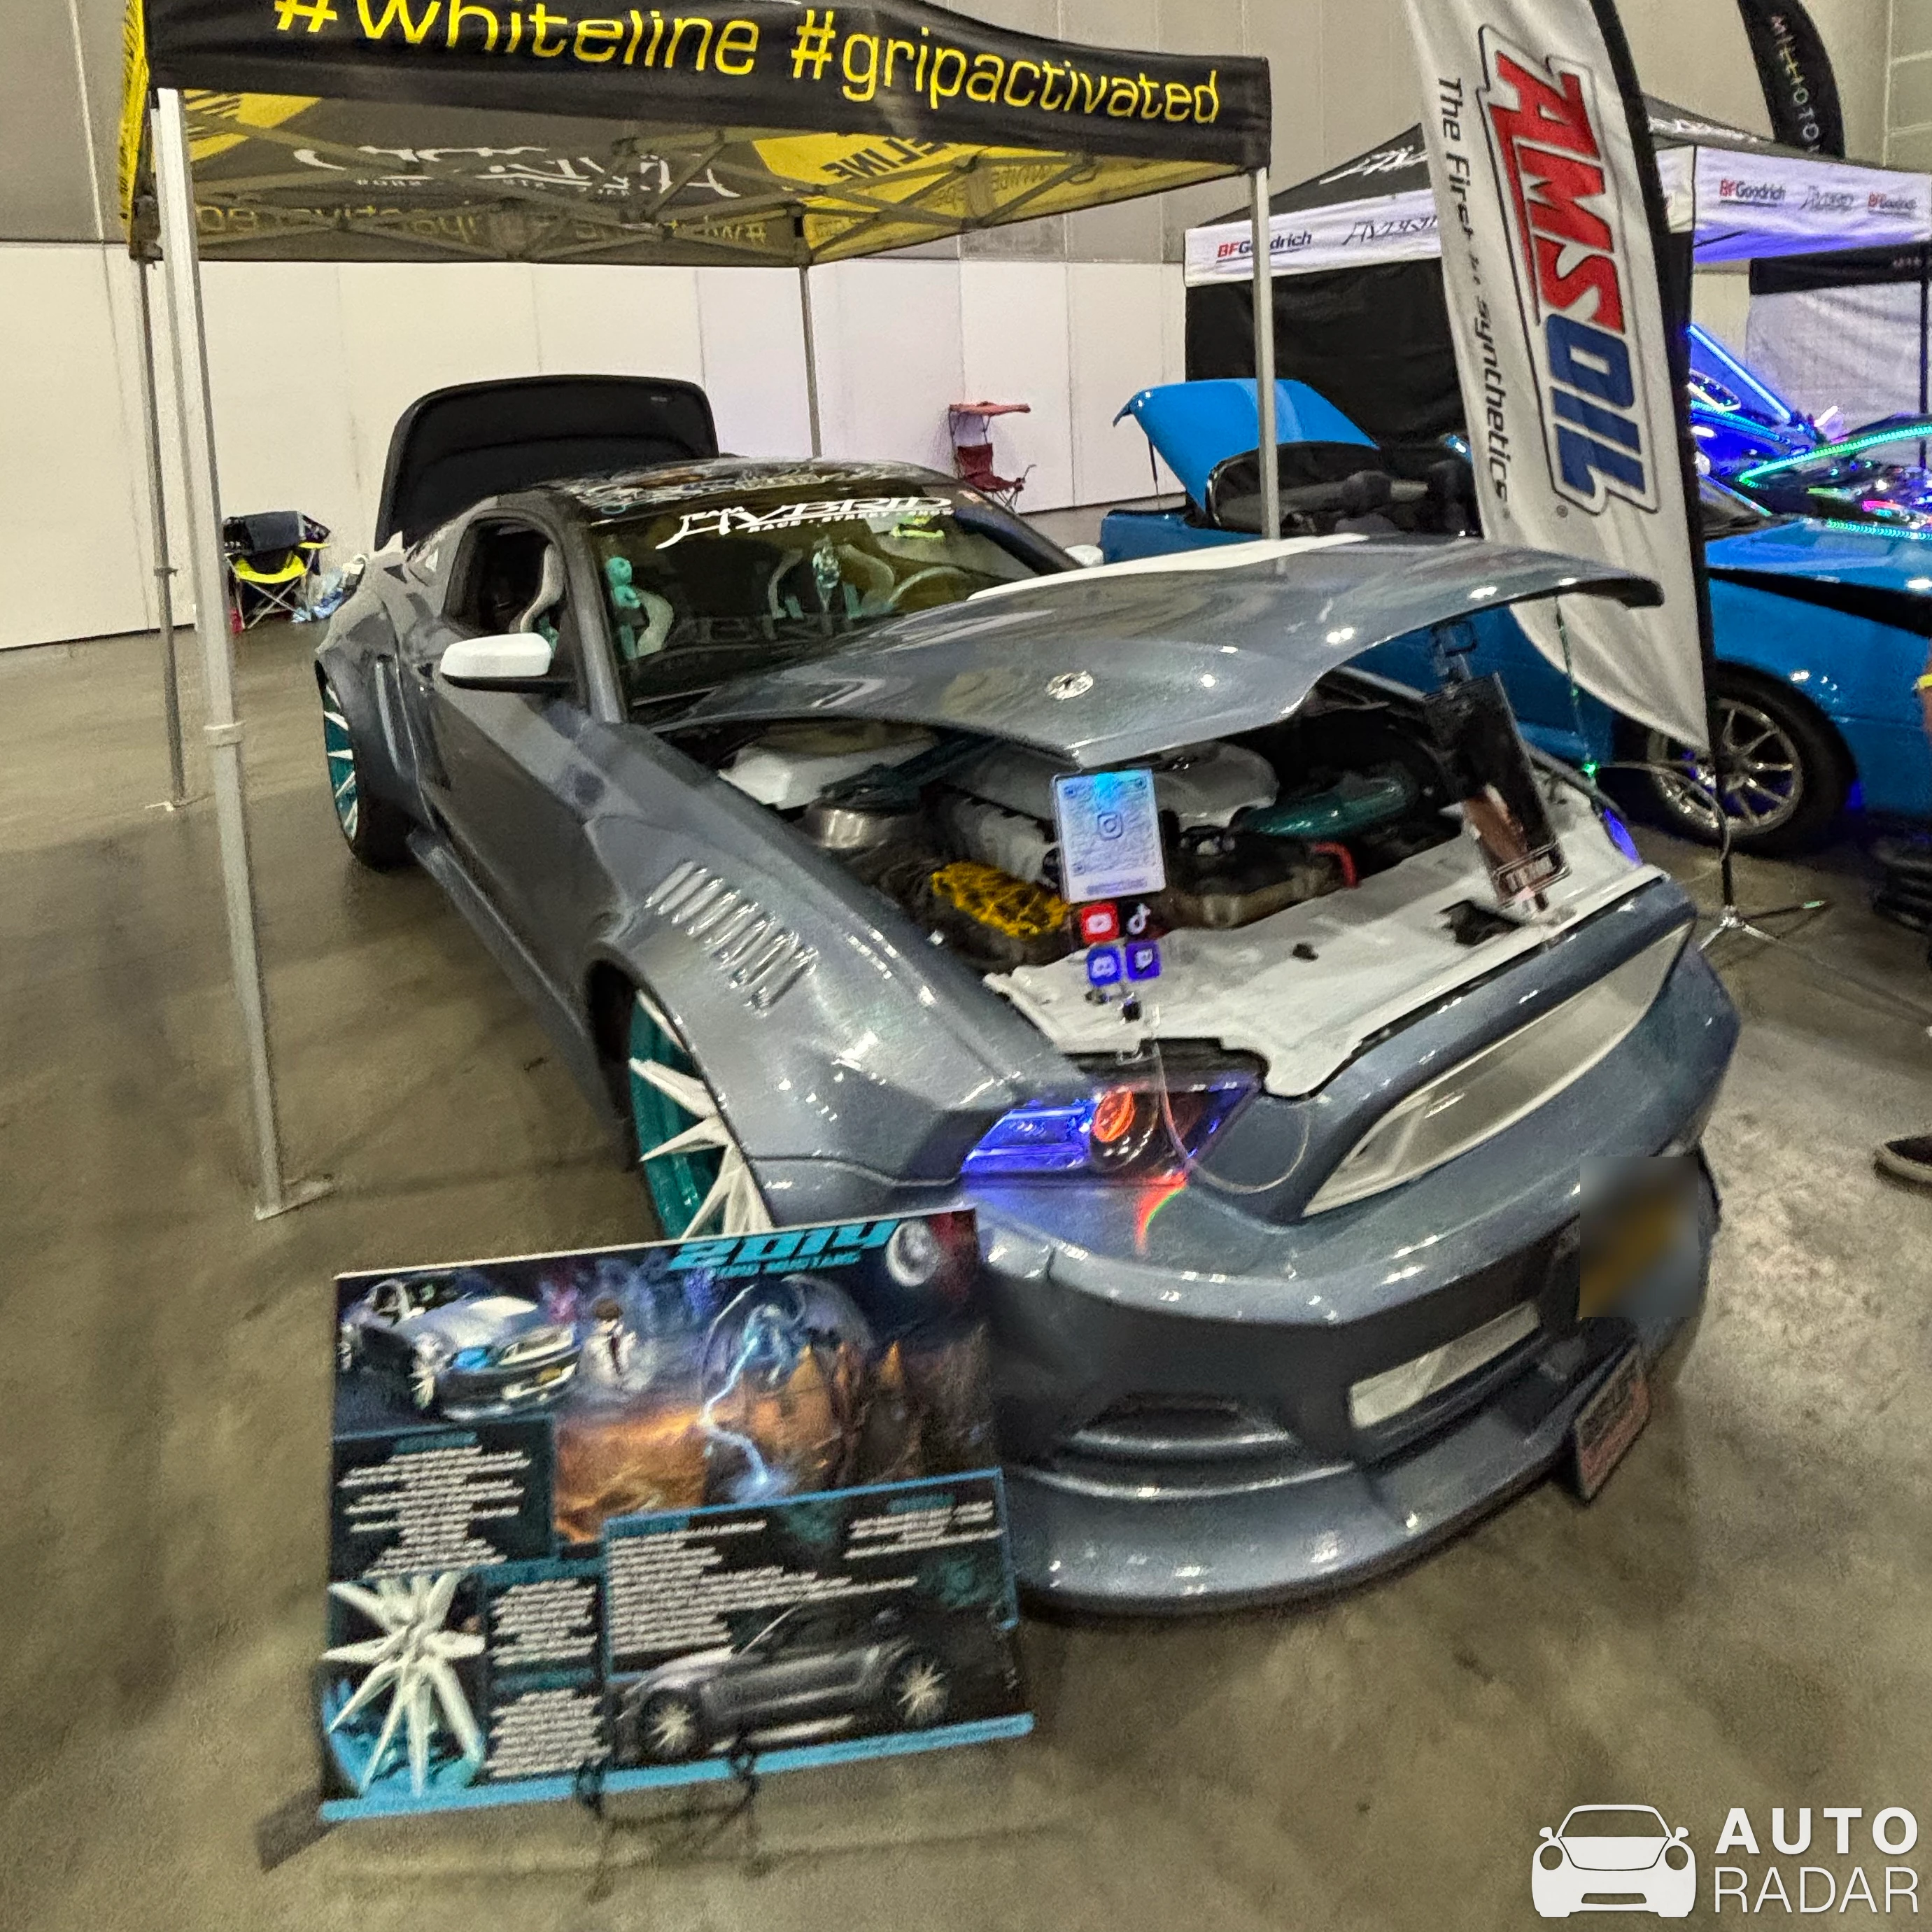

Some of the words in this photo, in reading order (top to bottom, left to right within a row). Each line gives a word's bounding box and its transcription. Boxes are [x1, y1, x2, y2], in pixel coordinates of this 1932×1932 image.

[274, 0, 759, 75] #Whiteline
[791, 10, 1220, 124] #gripactivated
[1218, 230, 1312, 258] BFGdrich
[1719, 178, 1786, 201] BFGoodrich
[1438, 78, 1464, 141] The
[1474, 296, 1511, 502] synthetics
[1488, 50, 1646, 497] AMSOIL
